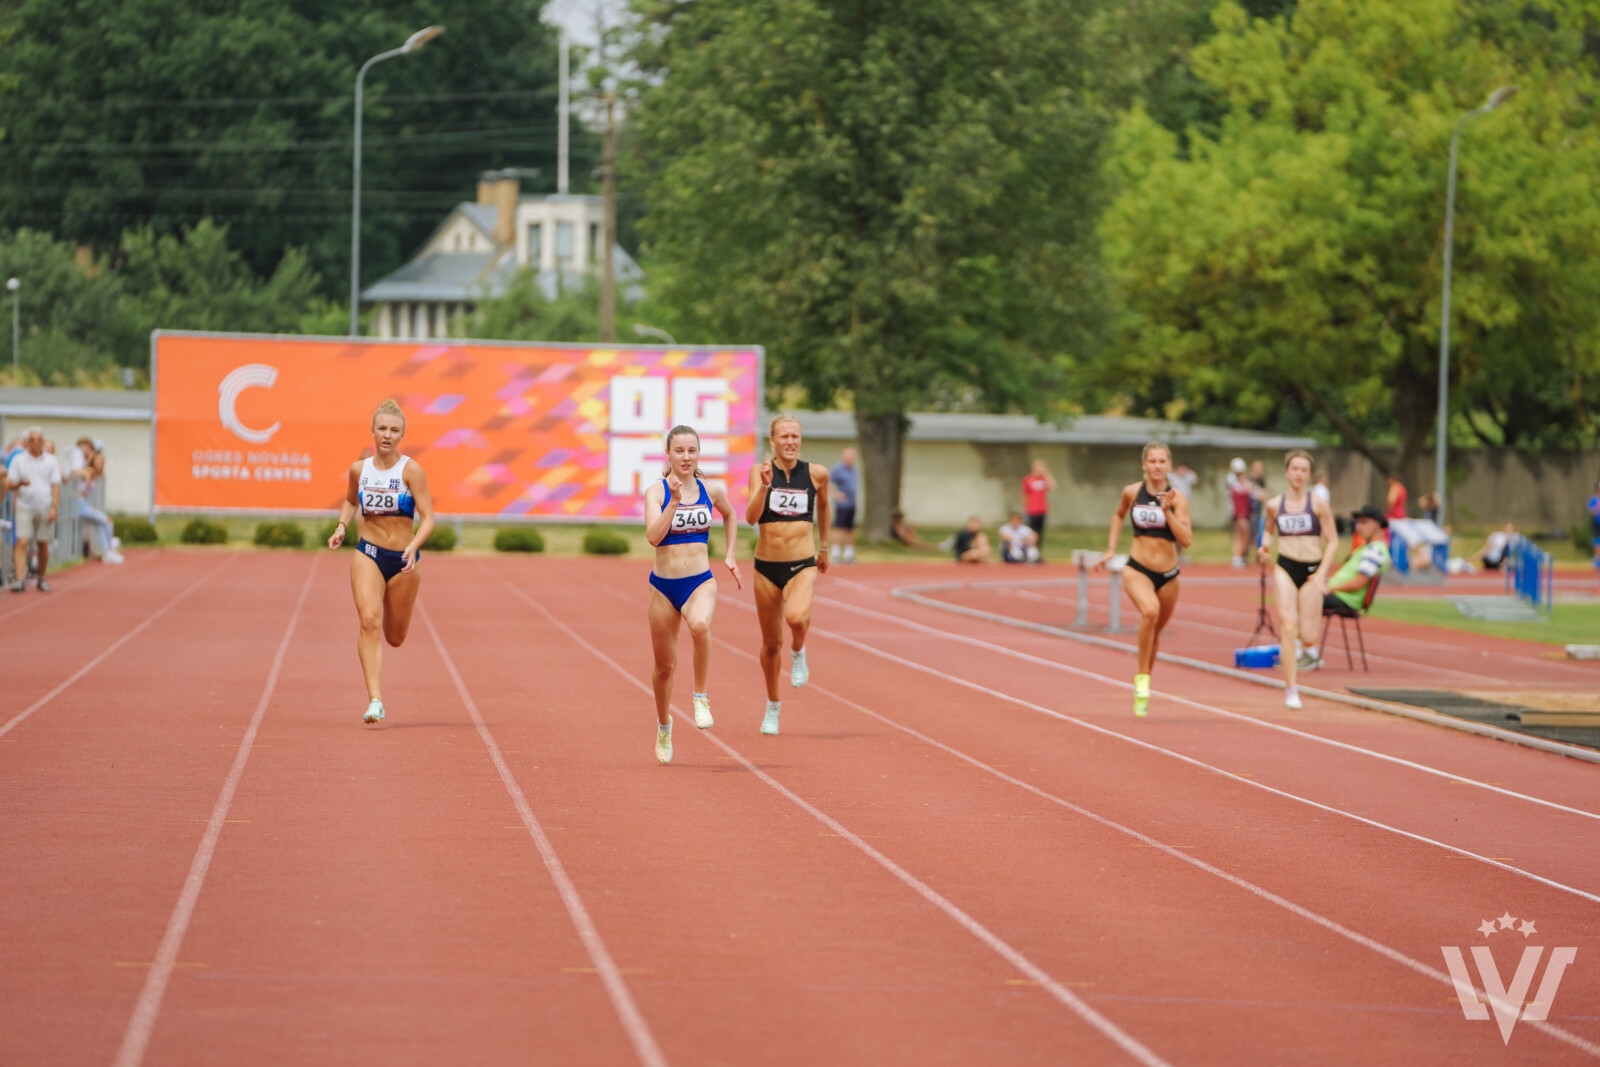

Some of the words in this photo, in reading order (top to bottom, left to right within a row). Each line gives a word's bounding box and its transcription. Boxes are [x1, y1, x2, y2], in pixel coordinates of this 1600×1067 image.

[192, 464, 250, 480] SPORTA
[254, 466, 312, 482] CENTRS
[366, 494, 394, 508] 228
[779, 495, 798, 509] 24
[676, 511, 707, 527] 340
[1285, 517, 1305, 529] 179
